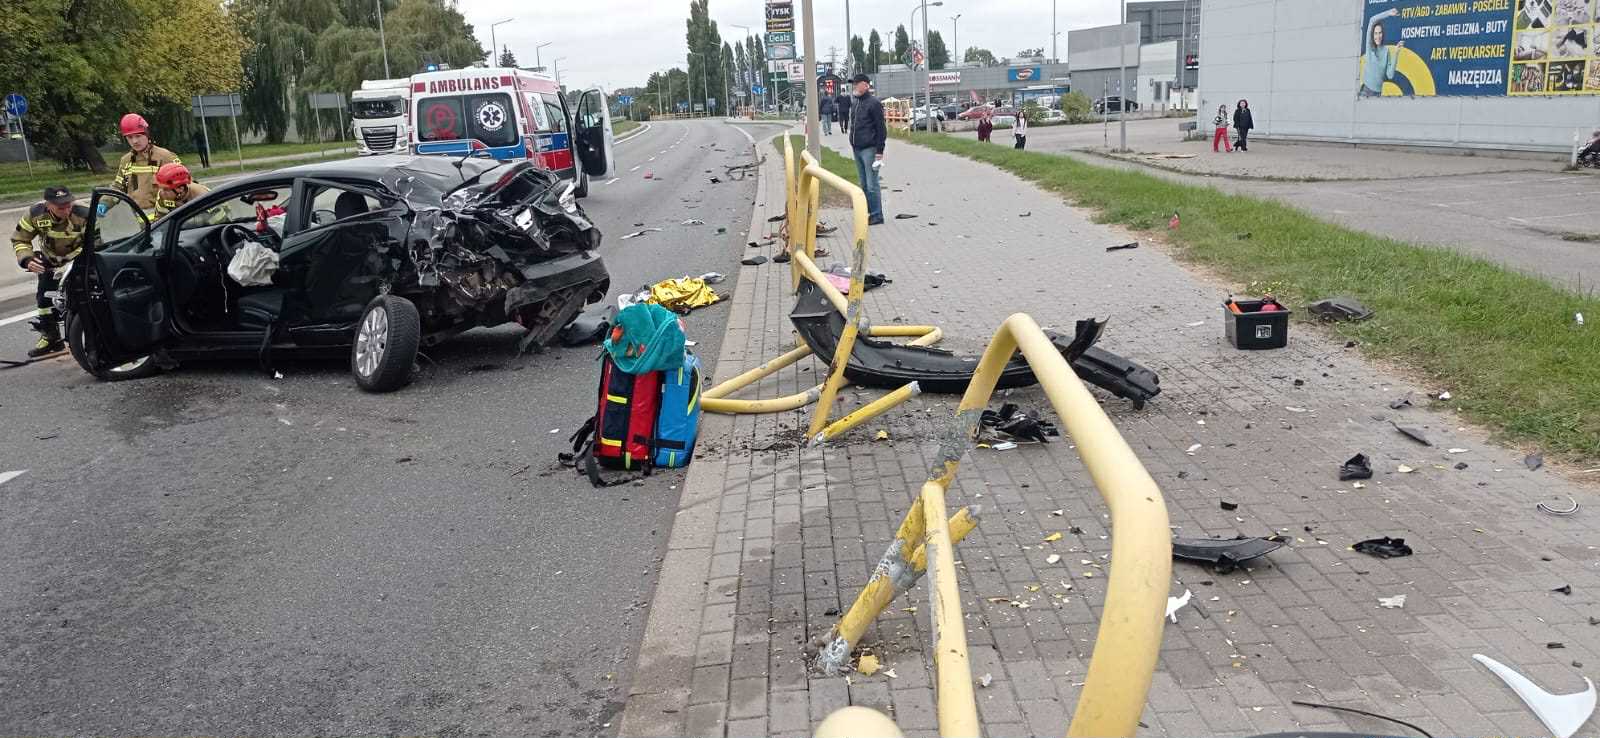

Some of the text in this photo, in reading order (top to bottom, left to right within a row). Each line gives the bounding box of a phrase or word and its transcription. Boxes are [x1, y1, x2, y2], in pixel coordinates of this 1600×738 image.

[1402, 6, 1430, 18] RTV/AGD
[1435, 3, 1467, 16] ZABAWKI
[1401, 20, 1508, 39] KOSMETYKI BIELIZNA BUTY
[1431, 44, 1505, 62] ART. WĘDKARSKIE
[430, 76, 499, 94] AMBULANS
[1448, 69, 1502, 88] NARZĘDZIA
